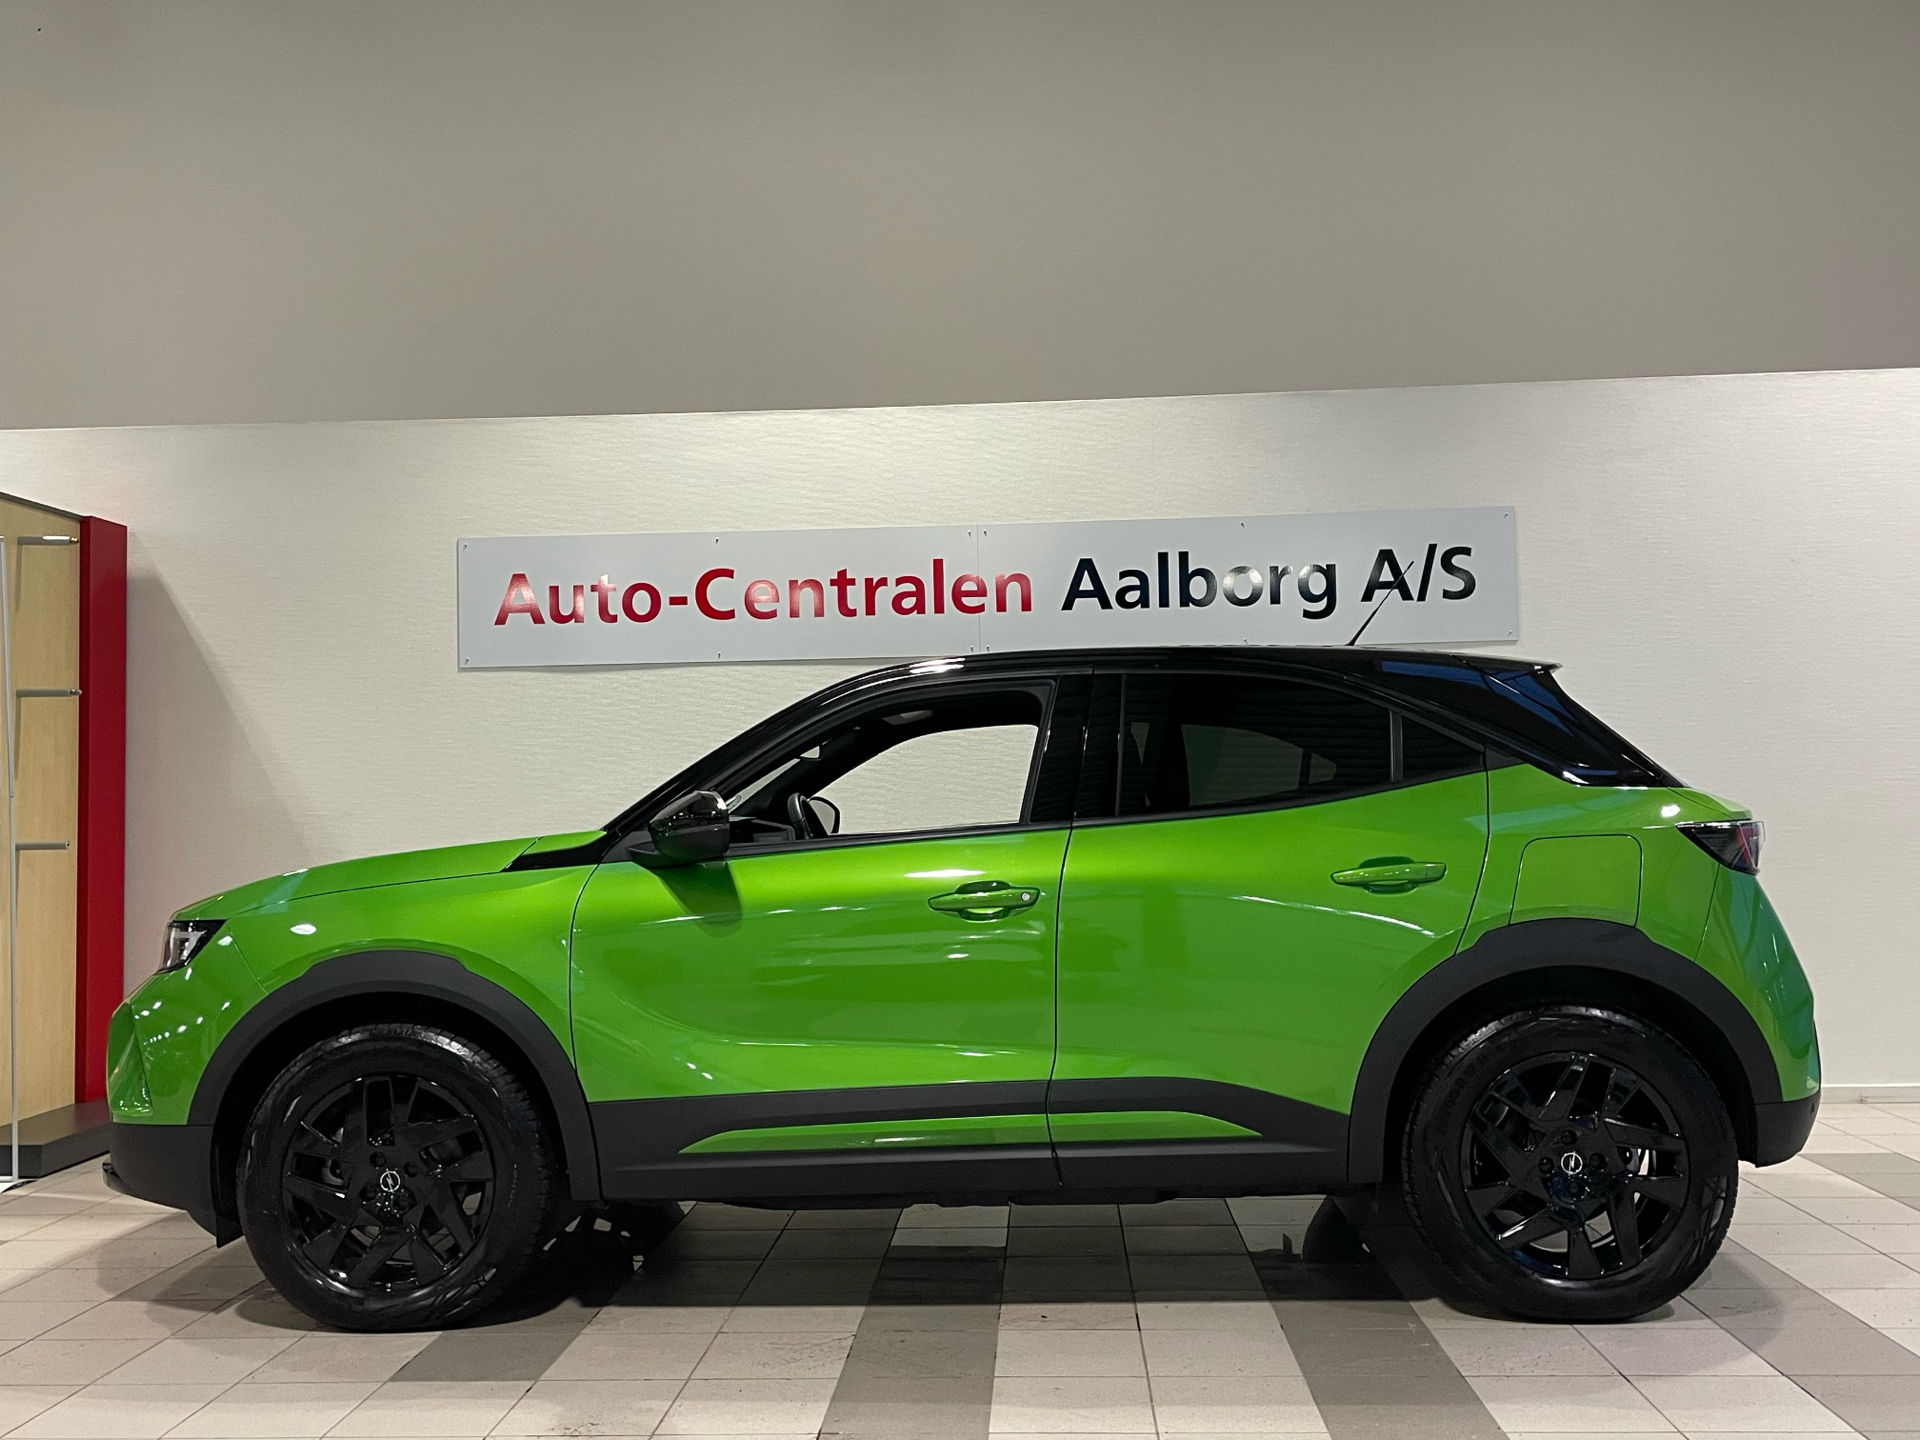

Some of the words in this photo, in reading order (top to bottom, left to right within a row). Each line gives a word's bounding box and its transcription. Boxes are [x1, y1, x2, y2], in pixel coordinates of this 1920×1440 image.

[494, 558, 1032, 626] Auto-Centralen
[1061, 551, 1336, 620] Aalborg
[1361, 543, 1476, 602] A/S
